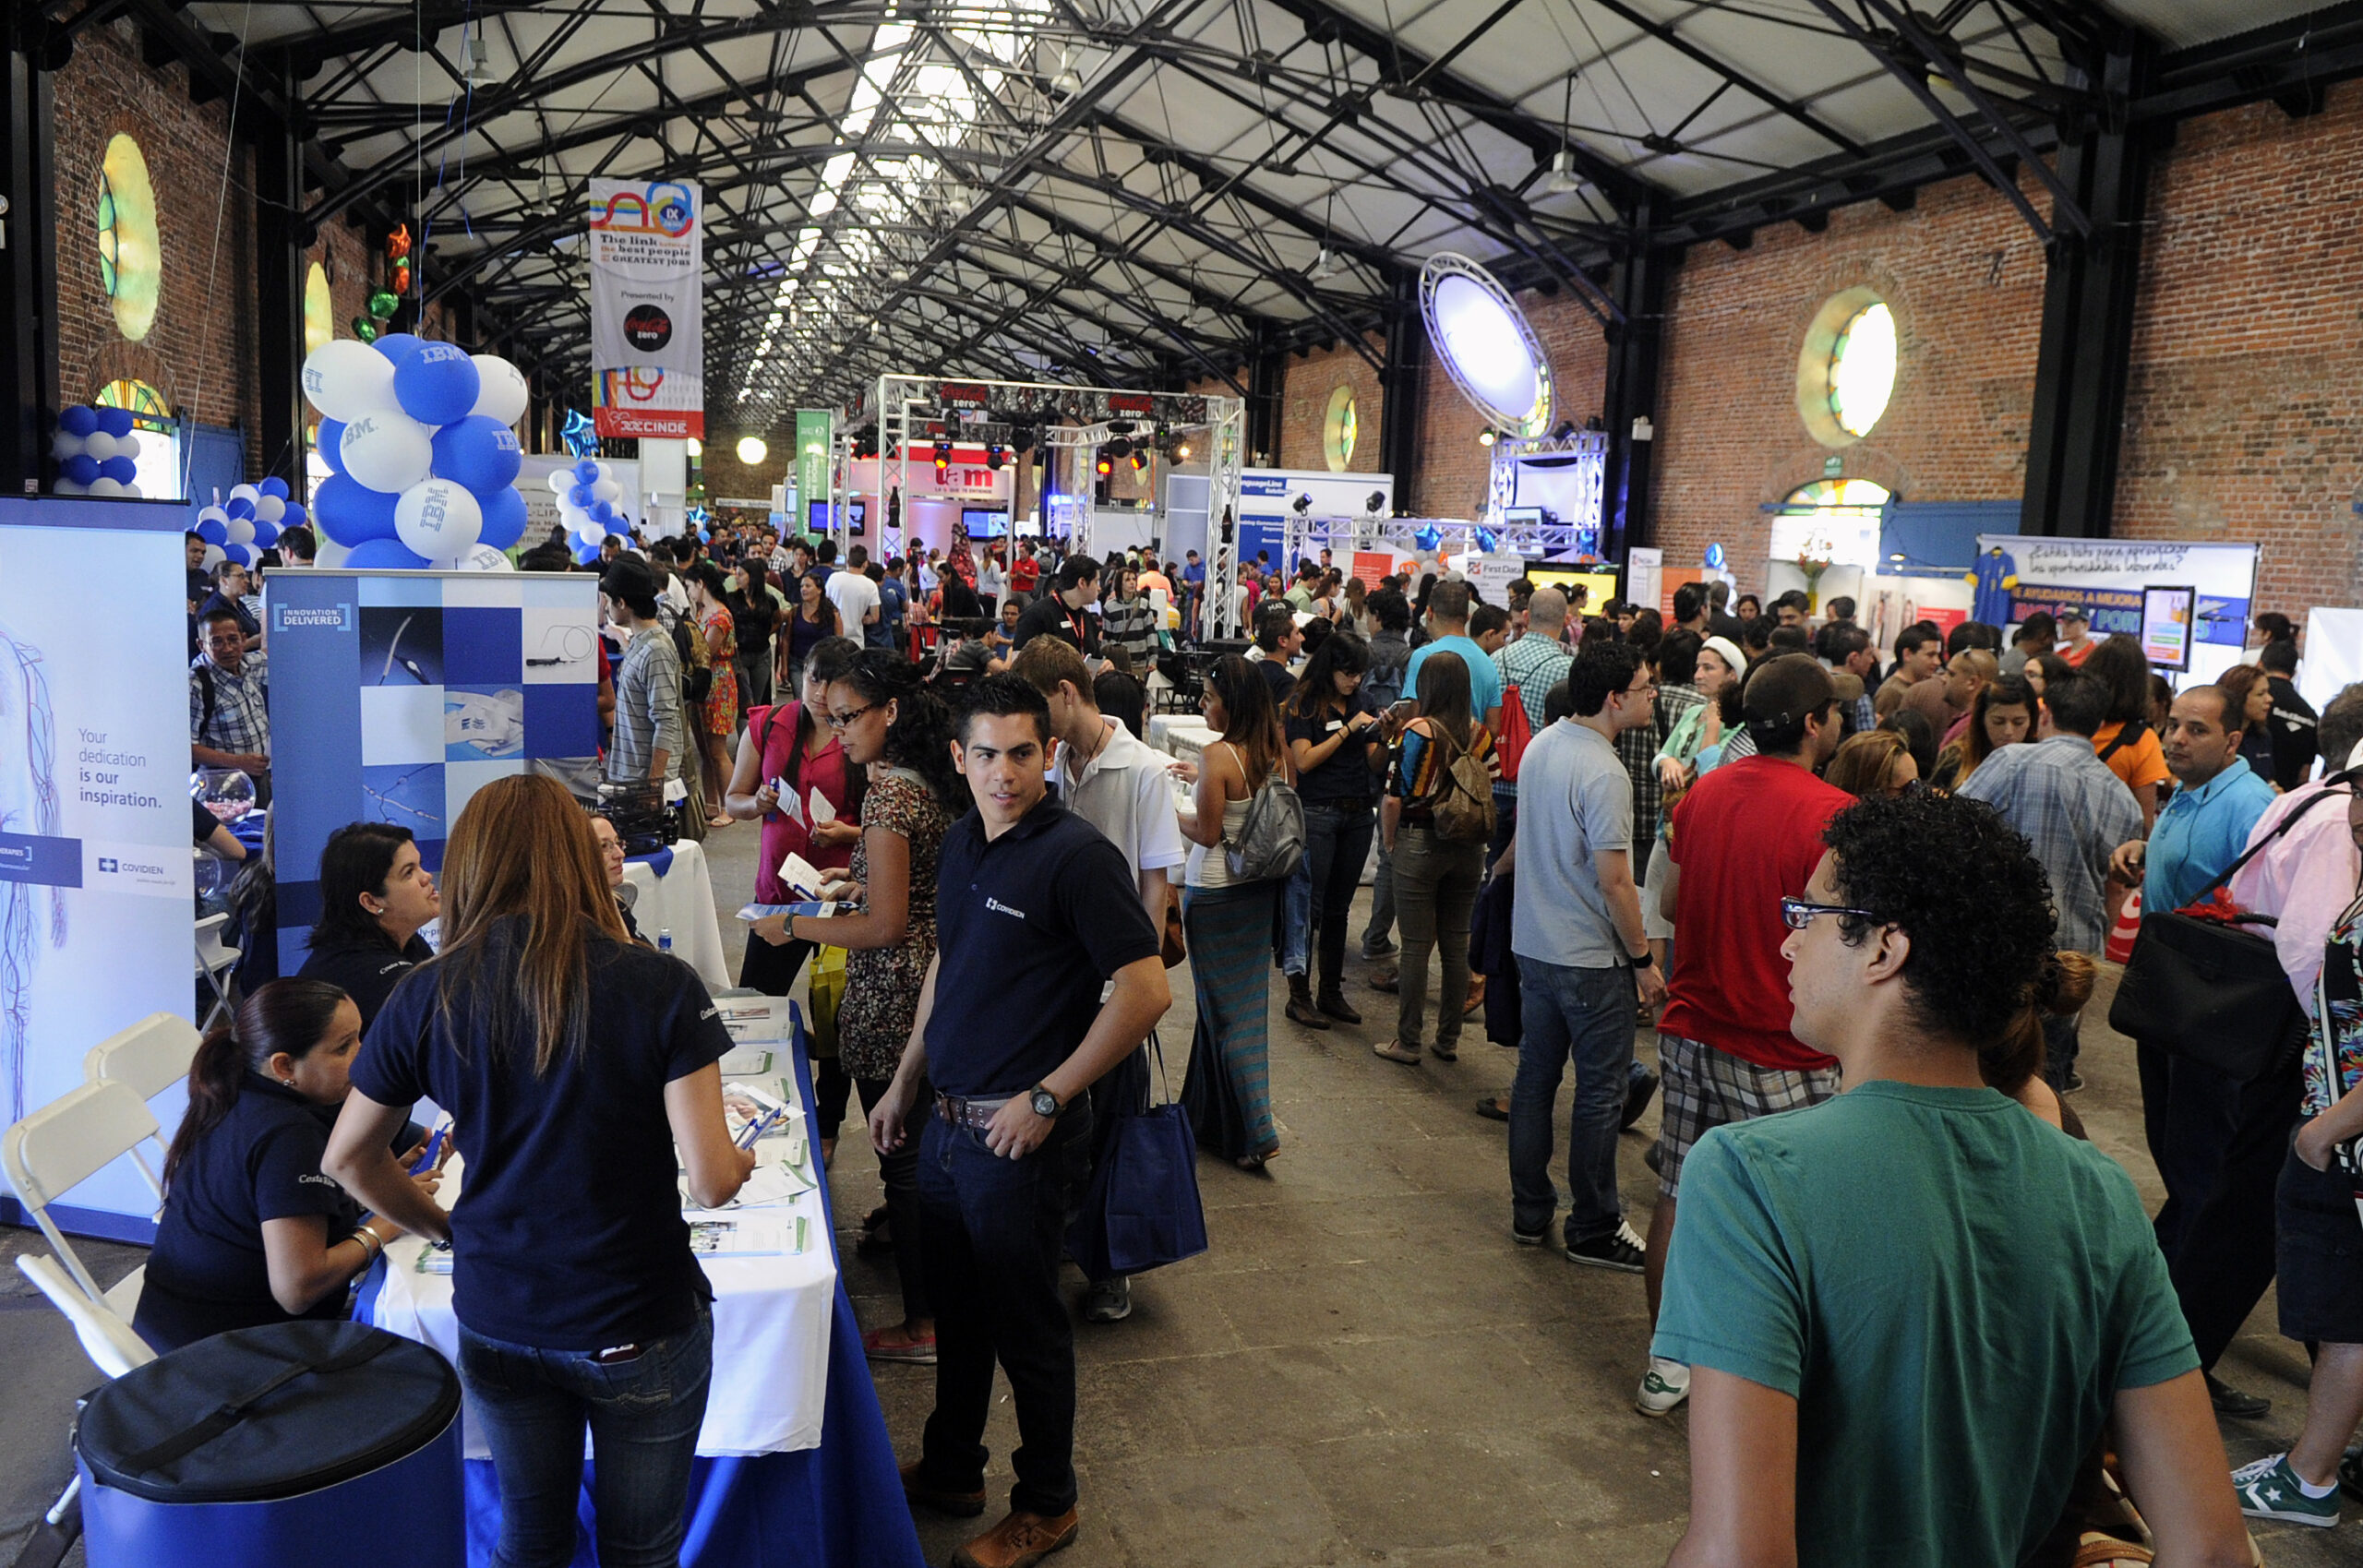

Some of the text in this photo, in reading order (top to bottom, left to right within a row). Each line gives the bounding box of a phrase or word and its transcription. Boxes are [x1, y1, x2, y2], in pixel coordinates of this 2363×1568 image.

[601, 233, 626, 244] The
[630, 236, 657, 246] link
[618, 245, 645, 254] best
[648, 248, 691, 257] people
[612, 255, 665, 266] GREATEST
[620, 290, 675, 303] Presented by
[637, 330, 658, 340] zero
[419, 346, 469, 365] IBM
[953, 399, 976, 408] zero
[1120, 409, 1142, 418] zero
[643, 421, 688, 434] CINDE
[1483, 564, 1523, 574] First Data
[283, 616, 342, 626] DELIVERED
[78, 727, 107, 744] Your
[79, 748, 147, 767] dedication
[79, 767, 119, 784] is our
[79, 786, 162, 808] inspiration.
[122, 863, 164, 875] COVIDIEN
[298, 1174, 323, 1184] Costa
